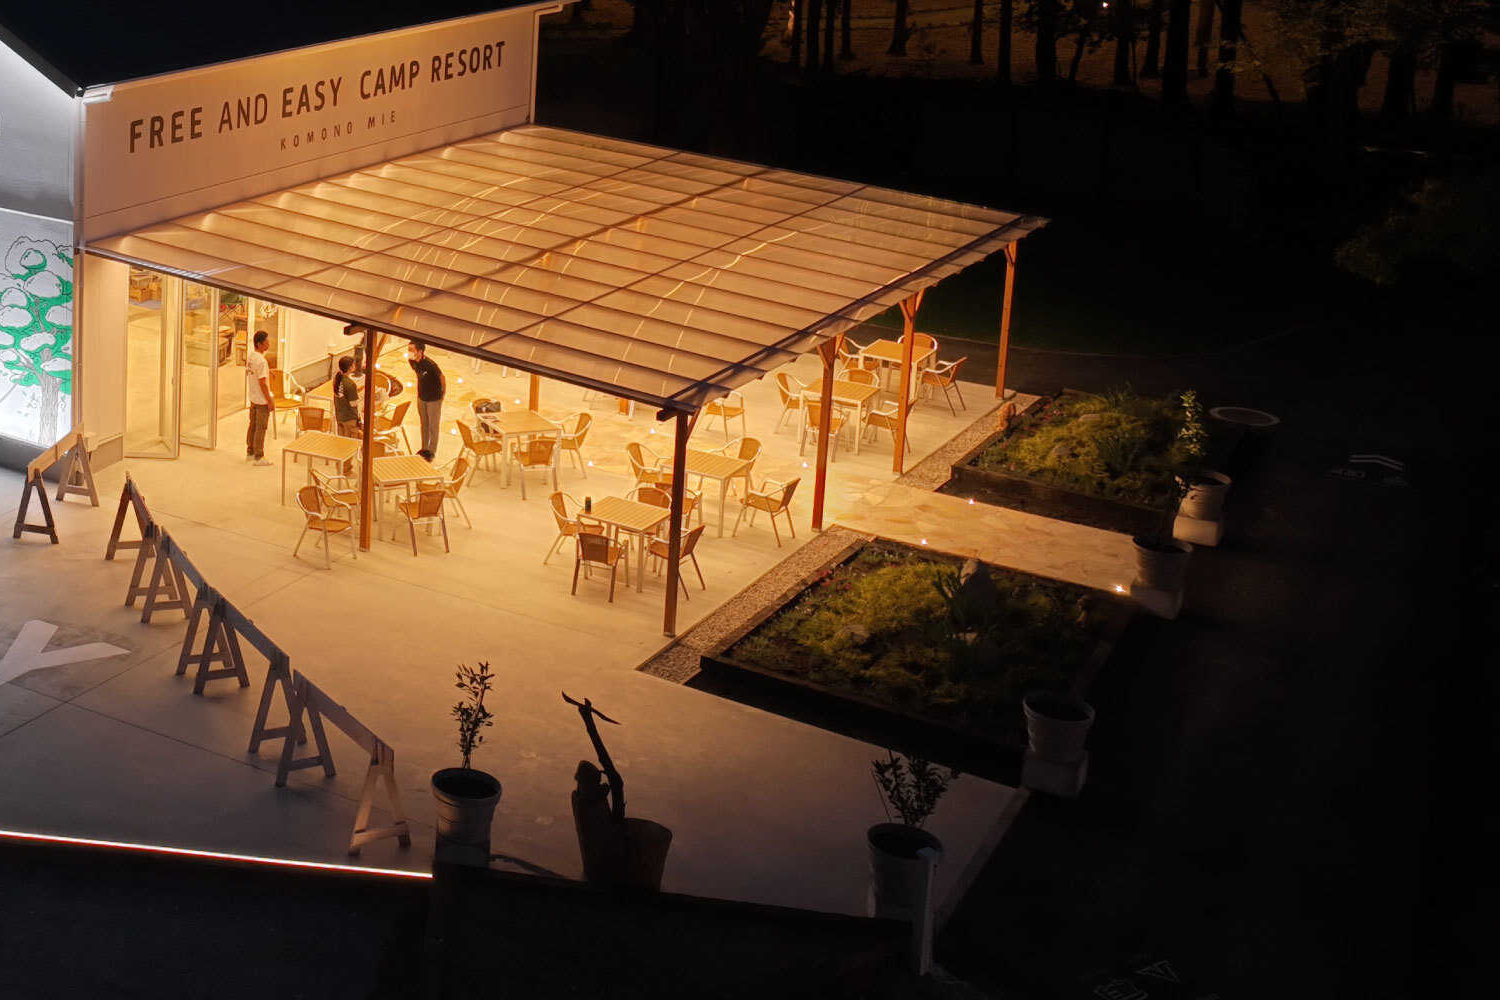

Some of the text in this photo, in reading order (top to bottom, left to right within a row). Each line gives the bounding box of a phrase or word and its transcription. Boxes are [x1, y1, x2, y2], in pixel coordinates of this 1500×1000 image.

[130, 40, 506, 153] FREE AND EASY CAMP RESORT
[280, 110, 397, 151] KOMONO MIE
